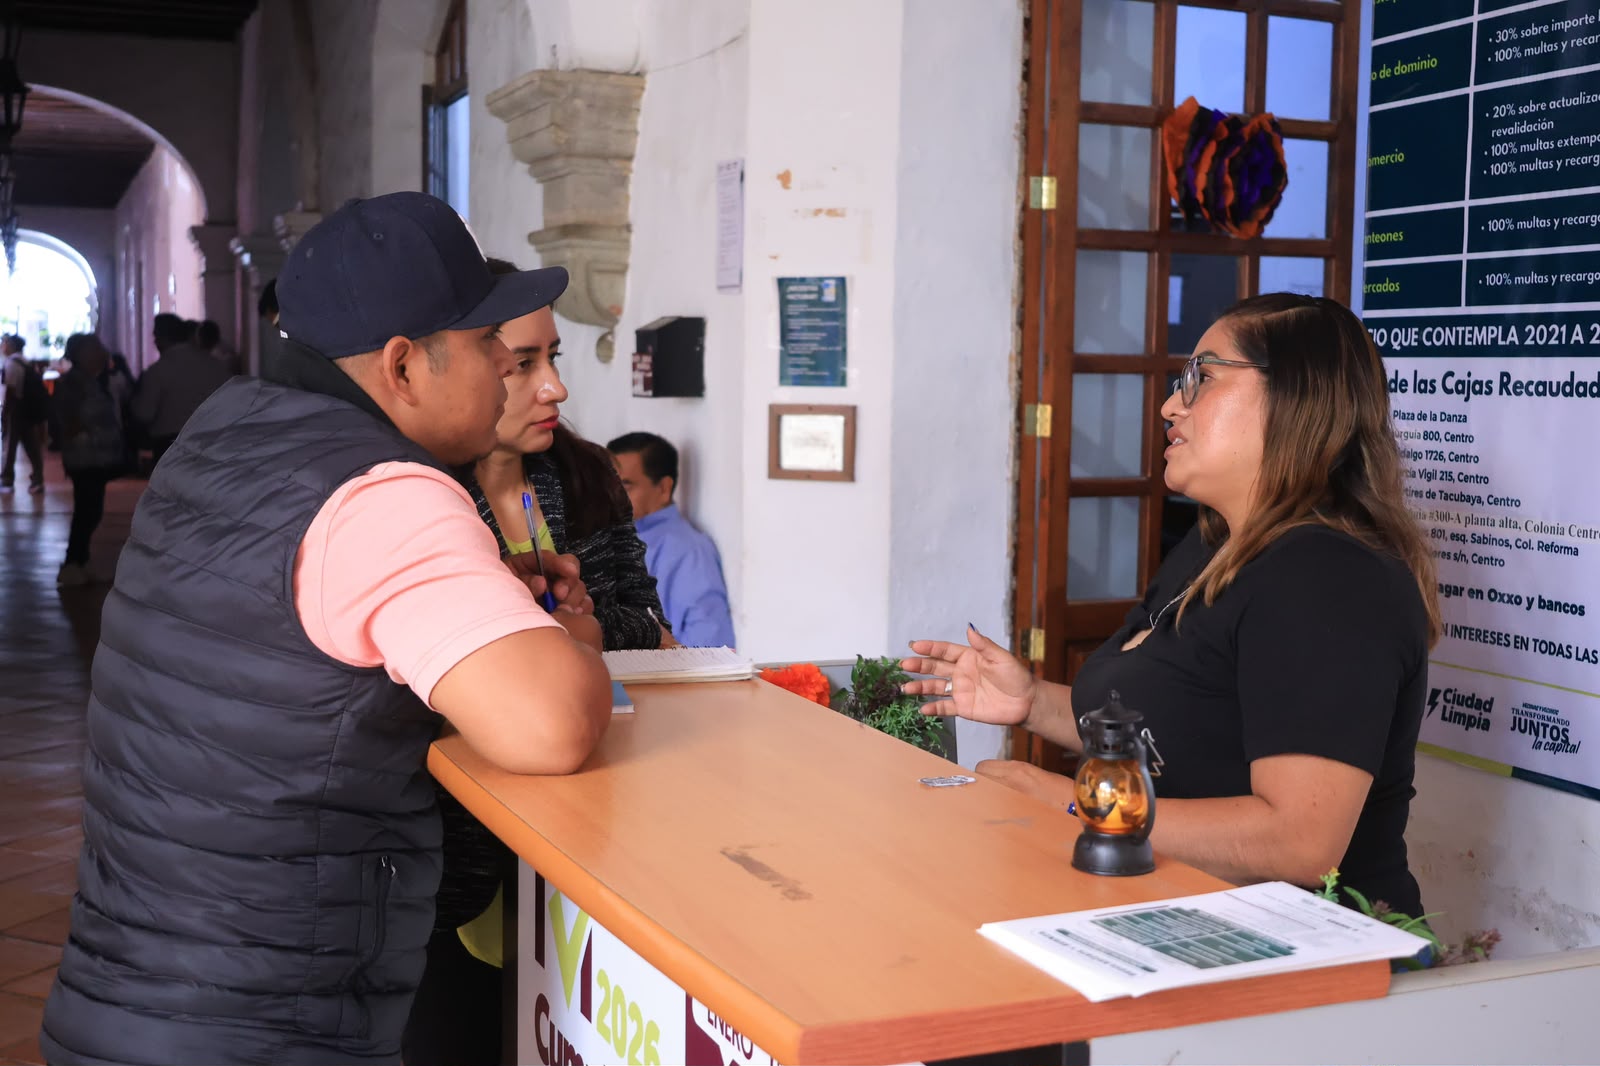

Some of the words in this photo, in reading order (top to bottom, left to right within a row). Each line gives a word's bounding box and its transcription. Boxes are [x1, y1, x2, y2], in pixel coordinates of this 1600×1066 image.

[1495, 27, 1518, 43] 30%
[1520, 23, 1549, 38] sobre
[1551, 13, 1595, 32] importe
[1494, 46, 1522, 62] 100%
[1524, 40, 1559, 57] multas
[1561, 40, 1568, 53] y
[1379, 63, 1391, 79] de
[1394, 53, 1438, 76] dominio
[1492, 103, 1516, 119] 20%
[1518, 99, 1547, 114] sobre
[1491, 117, 1554, 138] revalidación
[1490, 141, 1518, 157] 100%
[1520, 137, 1555, 153] multas
[1490, 161, 1517, 176] 100%
[1519, 157, 1554, 172] multas
[1556, 159, 1563, 172] y
[1488, 218, 1515, 232] 100%
[1516, 215, 1551, 230] multas
[1553, 218, 1560, 230] y
[1485, 272, 1512, 286] 100%
[1514, 271, 1549, 285] multas
[1551, 274, 1558, 286] y
[1560, 272, 1600, 285] recargo
[1367, 327, 1388, 347] IO
[1390, 327, 1419, 351] QUE
[1422, 325, 1519, 347] CONTEMPLA
[1523, 323, 1567, 345] 2021
[1570, 323, 1584, 345] A
[1388, 369, 1408, 394] de
[1413, 369, 1437, 395] las
[1441, 370, 1493, 402] Cajas
[1499, 371, 1600, 398] Recaudad
[1393, 409, 1415, 421] Plaza
[1417, 410, 1427, 421] de
[1429, 410, 1437, 422] la
[1440, 411, 1468, 423] Danza
[1423, 430, 1442, 443] 800,
[1444, 431, 1474, 443] Centro
[1425, 450, 1446, 463] 1726,
[1448, 451, 1479, 464] Centro
[1418, 468, 1437, 482] Vigil
[1440, 470, 1455, 483] 215,
[1457, 472, 1489, 484] Centro
[1425, 488, 1436, 499] de
[1439, 490, 1485, 506] Tacubaya,
[1487, 494, 1521, 508] Centro
[1429, 510, 1461, 524] #300-A
[1464, 513, 1496, 528] planta
[1499, 516, 1521, 531] alta,
[1524, 519, 1565, 536] Colonia
[1431, 528, 1448, 542] 801,
[1450, 532, 1468, 545] esq.
[1470, 533, 1512, 550] Sabinos,
[1515, 538, 1534, 551] Col.
[1537, 540, 1579, 556] Reforma
[1453, 550, 1469, 564] s/n,
[1471, 553, 1505, 568] Centro
[1467, 587, 1484, 601] en
[1487, 588, 1522, 606] Oxxo
[1525, 596, 1535, 611] y
[1538, 595, 1586, 617] bancos
[1450, 623, 1511, 648] INTERESES
[1513, 634, 1529, 652] EN
[1532, 638, 1573, 661] TODAS
[1575, 646, 1599, 665] LAS
[1442, 688, 1495, 713] Ciudad
[1441, 705, 1491, 732] Limpia
[1511, 707, 1570, 727] TRANSFORMANDO
[1510, 715, 1570, 744] JUNTOS
[1531, 736, 1543, 751] la
[1543, 740, 1582, 755] capital
